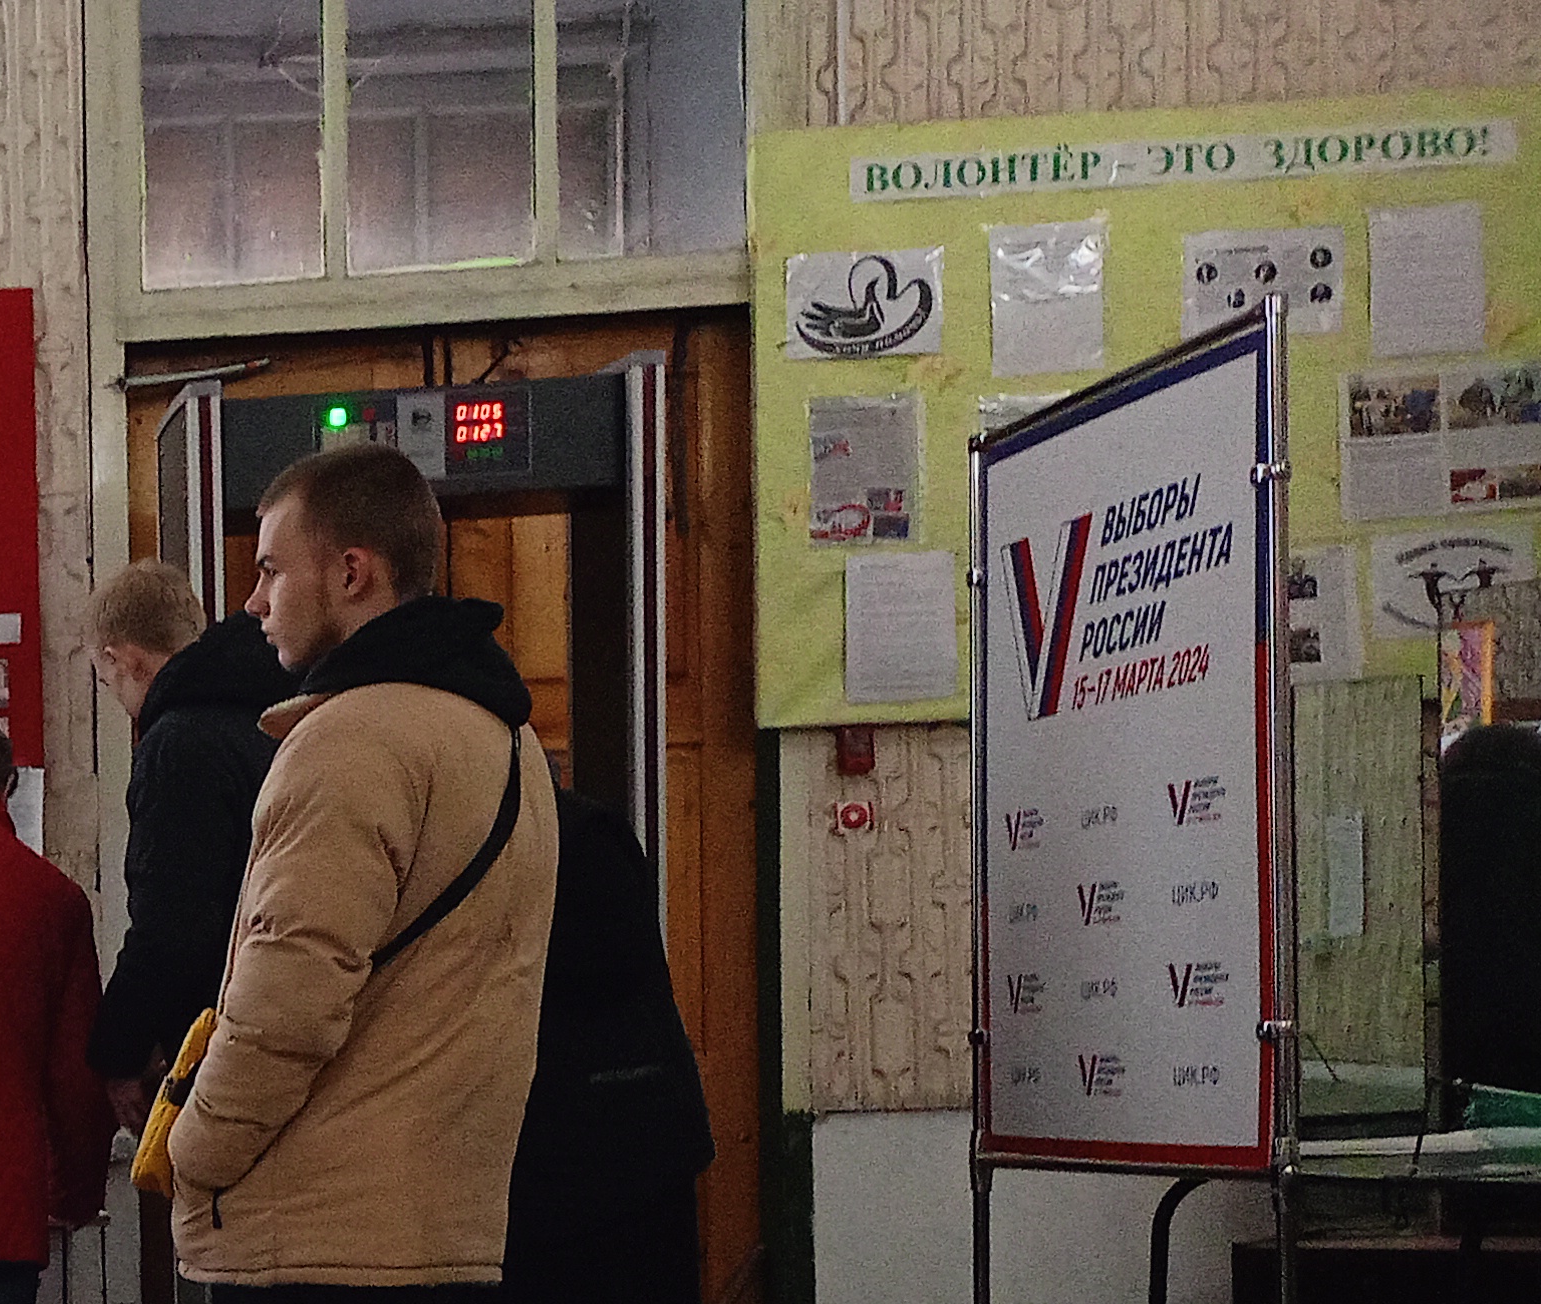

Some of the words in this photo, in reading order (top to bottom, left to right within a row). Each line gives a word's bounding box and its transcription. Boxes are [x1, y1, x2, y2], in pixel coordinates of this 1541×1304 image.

[865, 142, 1101, 193] ВОЛОНТЁР
[1147, 140, 1236, 175] ЭТО
[1263, 125, 1489, 174] ЗДОРОВО!
[1101, 472, 1202, 548] ВЫБОРЫ
[1089, 521, 1233, 606] ПРЕЗИДЕНТА
[1078, 600, 1167, 663] РОССИИ
[1112, 653, 1165, 703] МАРТА
[1166, 643, 1210, 690] 2024
